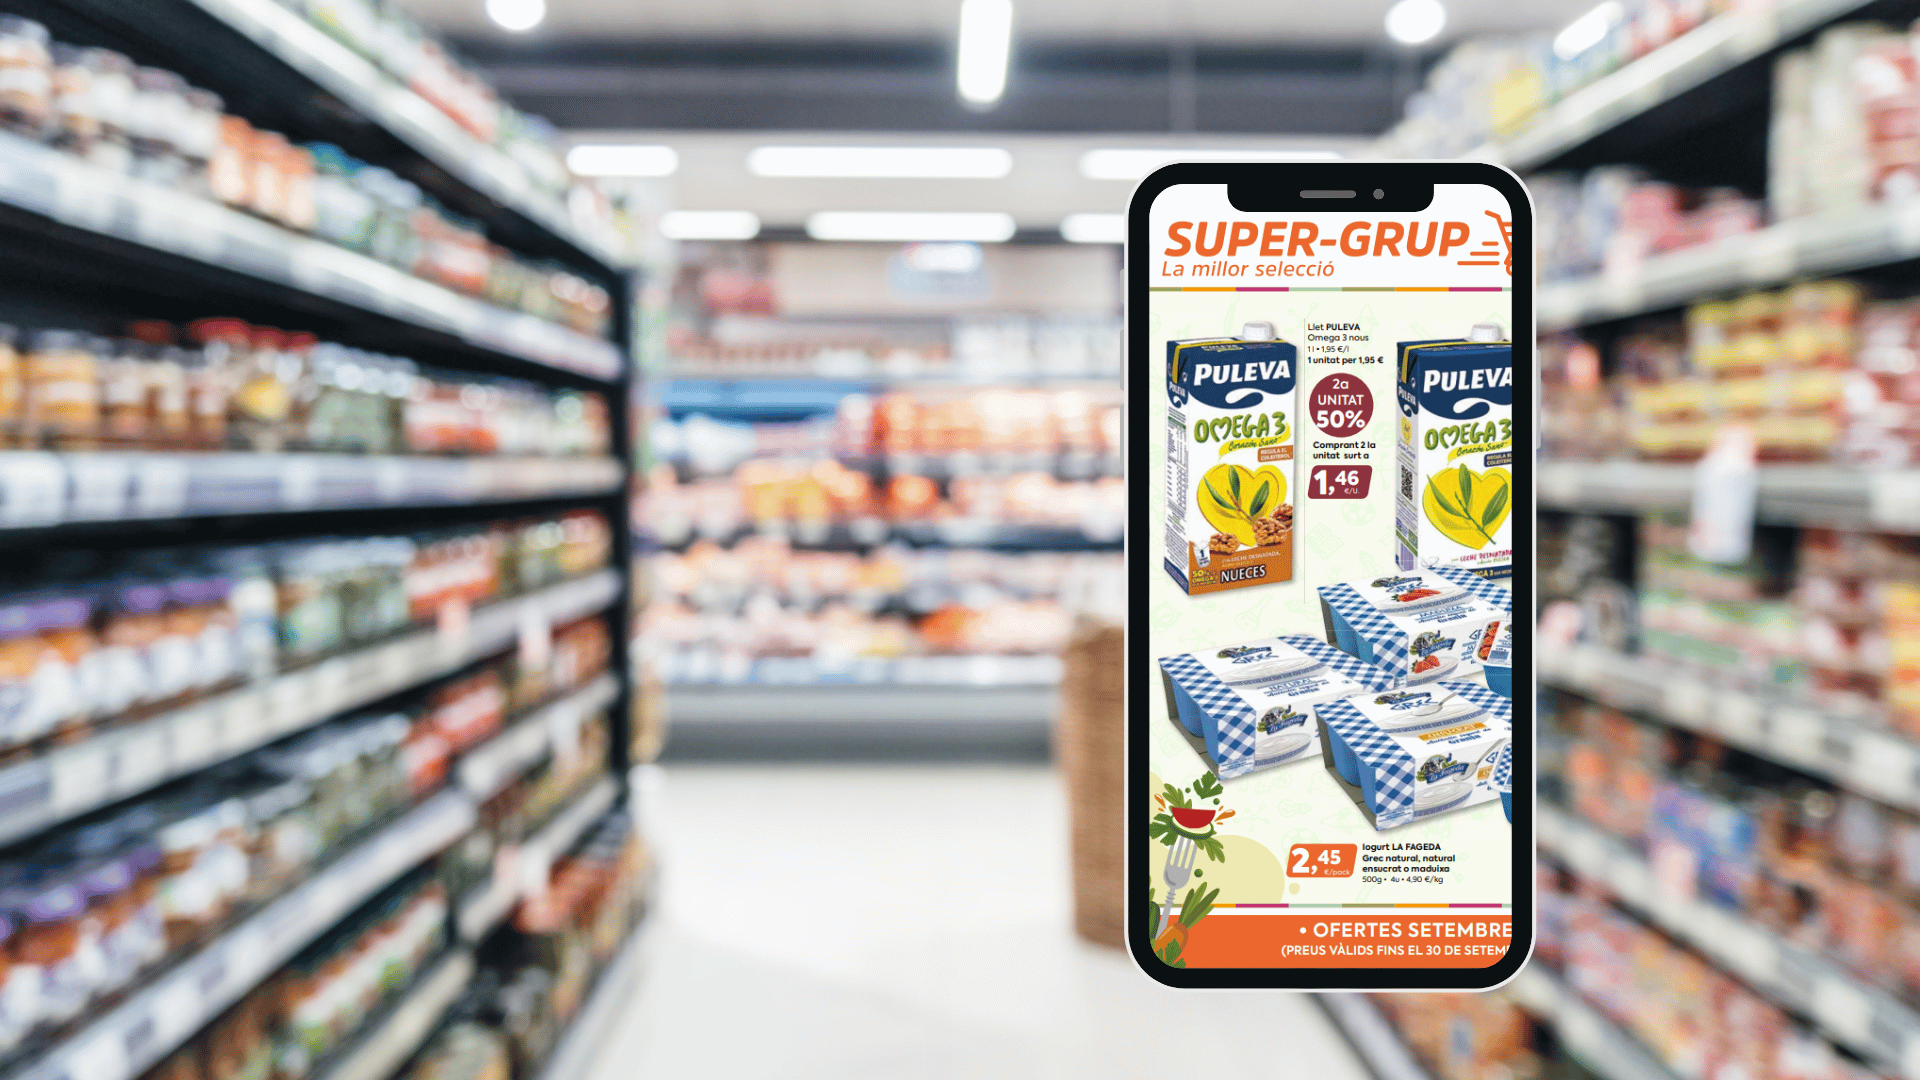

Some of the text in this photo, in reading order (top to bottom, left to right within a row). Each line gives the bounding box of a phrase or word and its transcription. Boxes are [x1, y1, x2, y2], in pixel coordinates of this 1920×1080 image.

[1164, 221, 1470, 257] SUPER-GRUP
[1162, 261, 1335, 277] La millor selecció
[1307, 323, 1361, 331] Llet PULEVA
[1307, 334, 1340, 343] Omega
[1307, 356, 1311, 364] 1
[1313, 356, 1340, 364] unitat
[1342, 357, 1357, 365] per
[1359, 356, 1375, 365] 1,95
[1193, 360, 1291, 386] PULEVA
[1332, 378, 1349, 389] 2a
[1317, 394, 1364, 405] UNITAT
[1316, 410, 1365, 428] 50%
[1194, 411, 1286, 443] OMEGA 3
[1424, 421, 1496, 450] OMEGA
[1498, 418, 1512, 441] 3
[1313, 441, 1359, 450] Comprant
[1367, 441, 1376, 449] la
[1221, 564, 1266, 582] NUECES
[1362, 843, 1390, 852] Iogurt
[1385, 854, 1421, 863] natural,
[1422, 854, 1456, 862] natural
[1324, 868, 1351, 876] €/pack
[1362, 876, 1383, 884] 500g
[1424, 876, 1443, 884] €/kg
[1313, 922, 1512, 938] OFERTES SETEMBRE
[1281, 942, 1510, 958] (PREUS VÀLIDS FINS EL 30 DE SETEM
